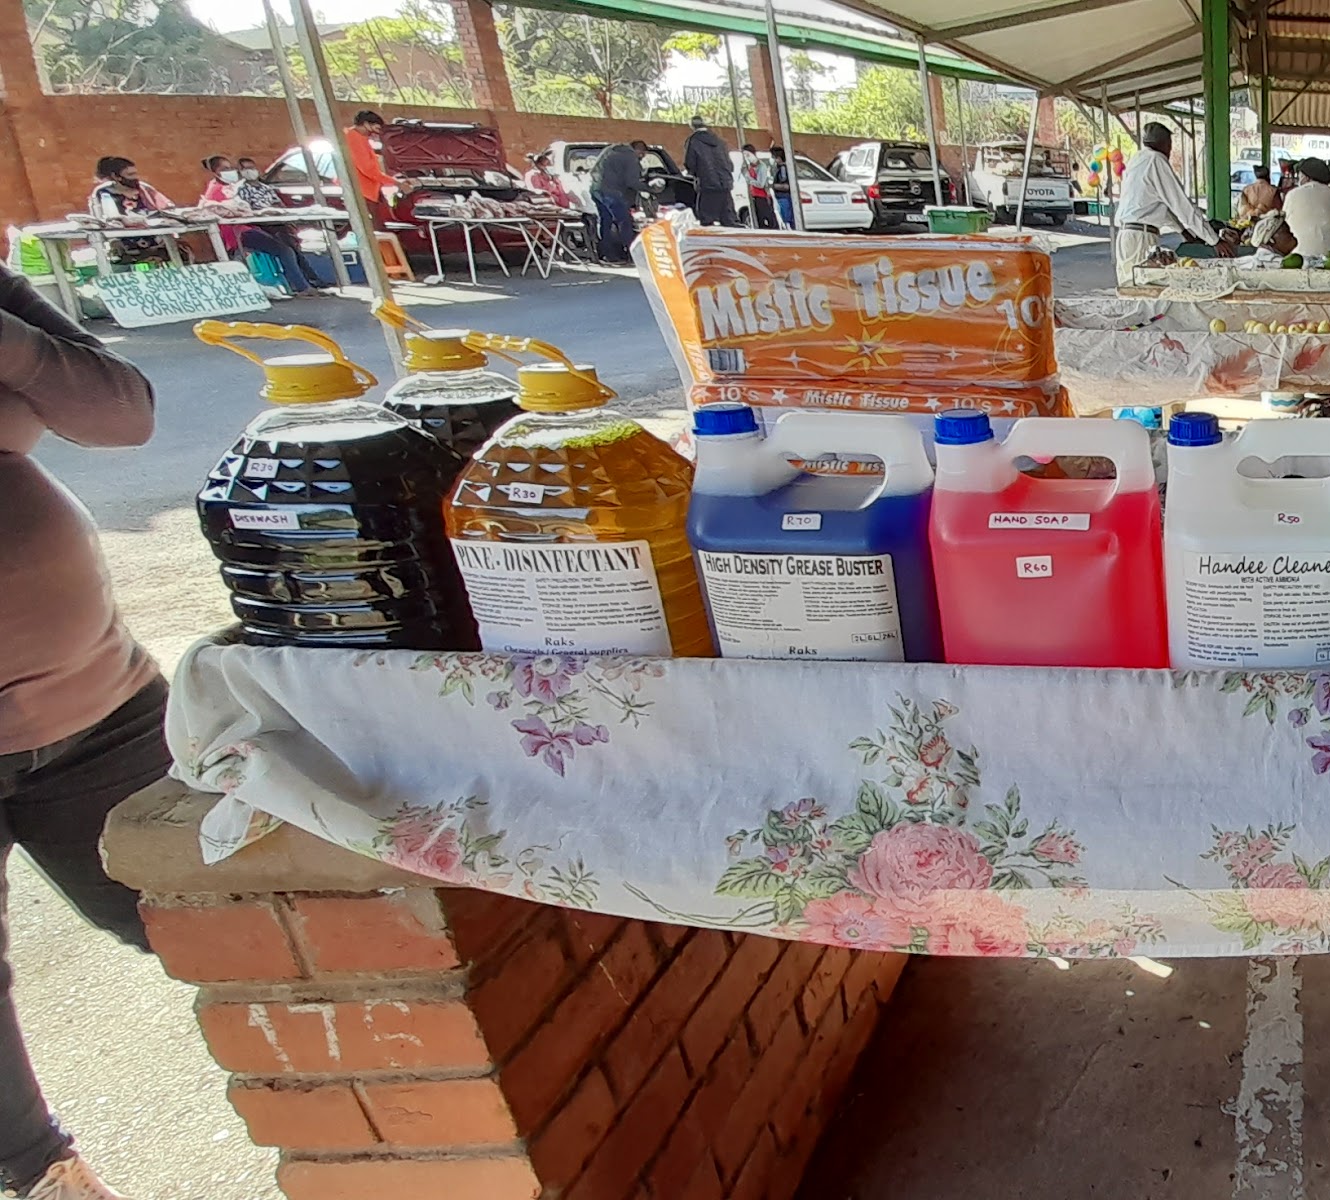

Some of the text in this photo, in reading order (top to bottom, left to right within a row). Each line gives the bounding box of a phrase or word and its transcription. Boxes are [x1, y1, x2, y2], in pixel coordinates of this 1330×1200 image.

[1027, 188, 1055, 196] OYOTA
[105, 299, 126, 309] TO
[127, 293, 164, 306] COOK
[696, 256, 995, 342] Mistic Tissue
[804, 390, 910, 409] Mistic Tissue
[512, 487, 537, 499] R30
[233, 513, 289, 525] DISHWASH
[786, 515, 812, 526] R70
[994, 515, 1069, 525] HAND SOAP
[1277, 512, 1300, 524] R50
[454, 543, 495, 570] PINE
[502, 546, 641, 574] DISINFECTANT
[786, 553, 834, 577] GREASE
[836, 558, 884, 577] BUSTER
[1023, 562, 1048, 574] R60
[1198, 555, 1268, 575] Handee
[544, 637, 575, 646] Raks
[788, 645, 818, 656] Raks
